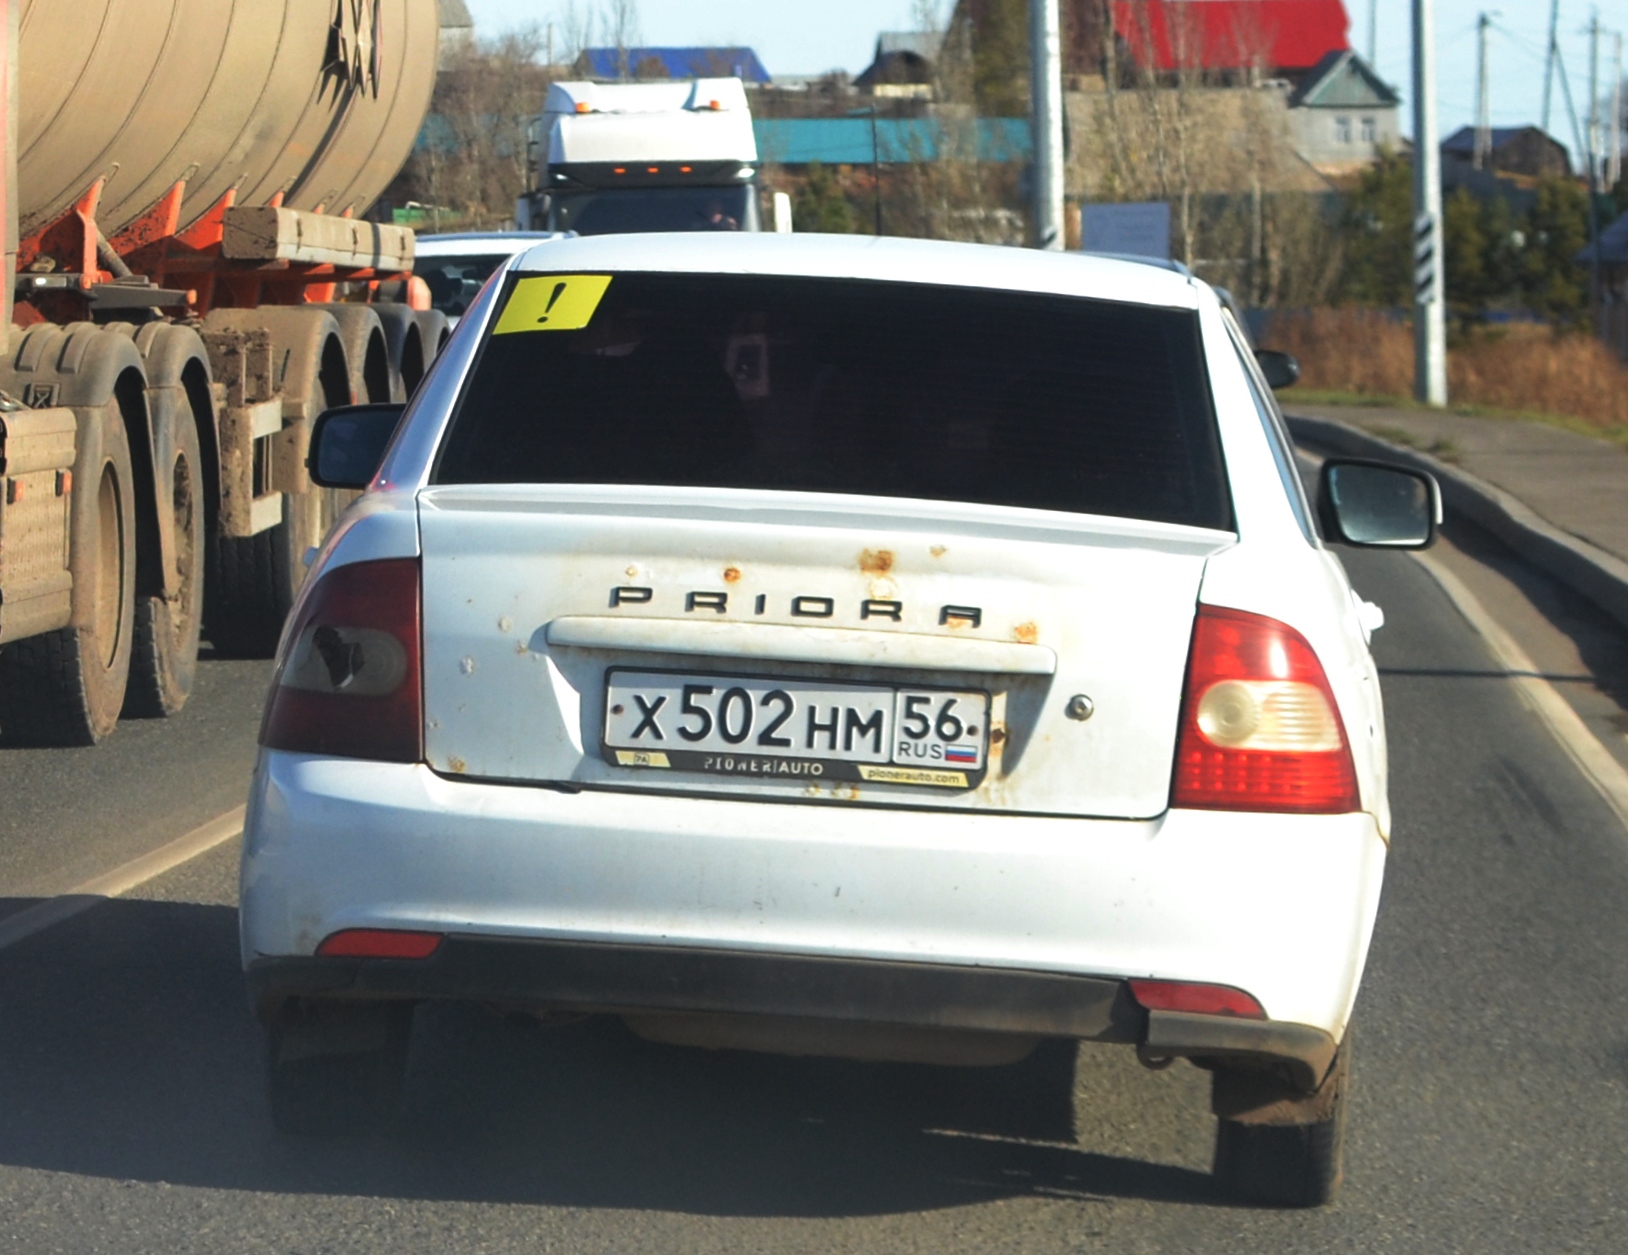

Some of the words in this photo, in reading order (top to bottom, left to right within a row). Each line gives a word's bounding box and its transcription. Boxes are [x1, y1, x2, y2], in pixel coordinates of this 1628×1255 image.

[608, 585, 983, 629] PRIORA
[902, 694, 964, 743] 56
[898, 740, 943, 760] RUS
[867, 767, 961, 784] pionerauto.com
